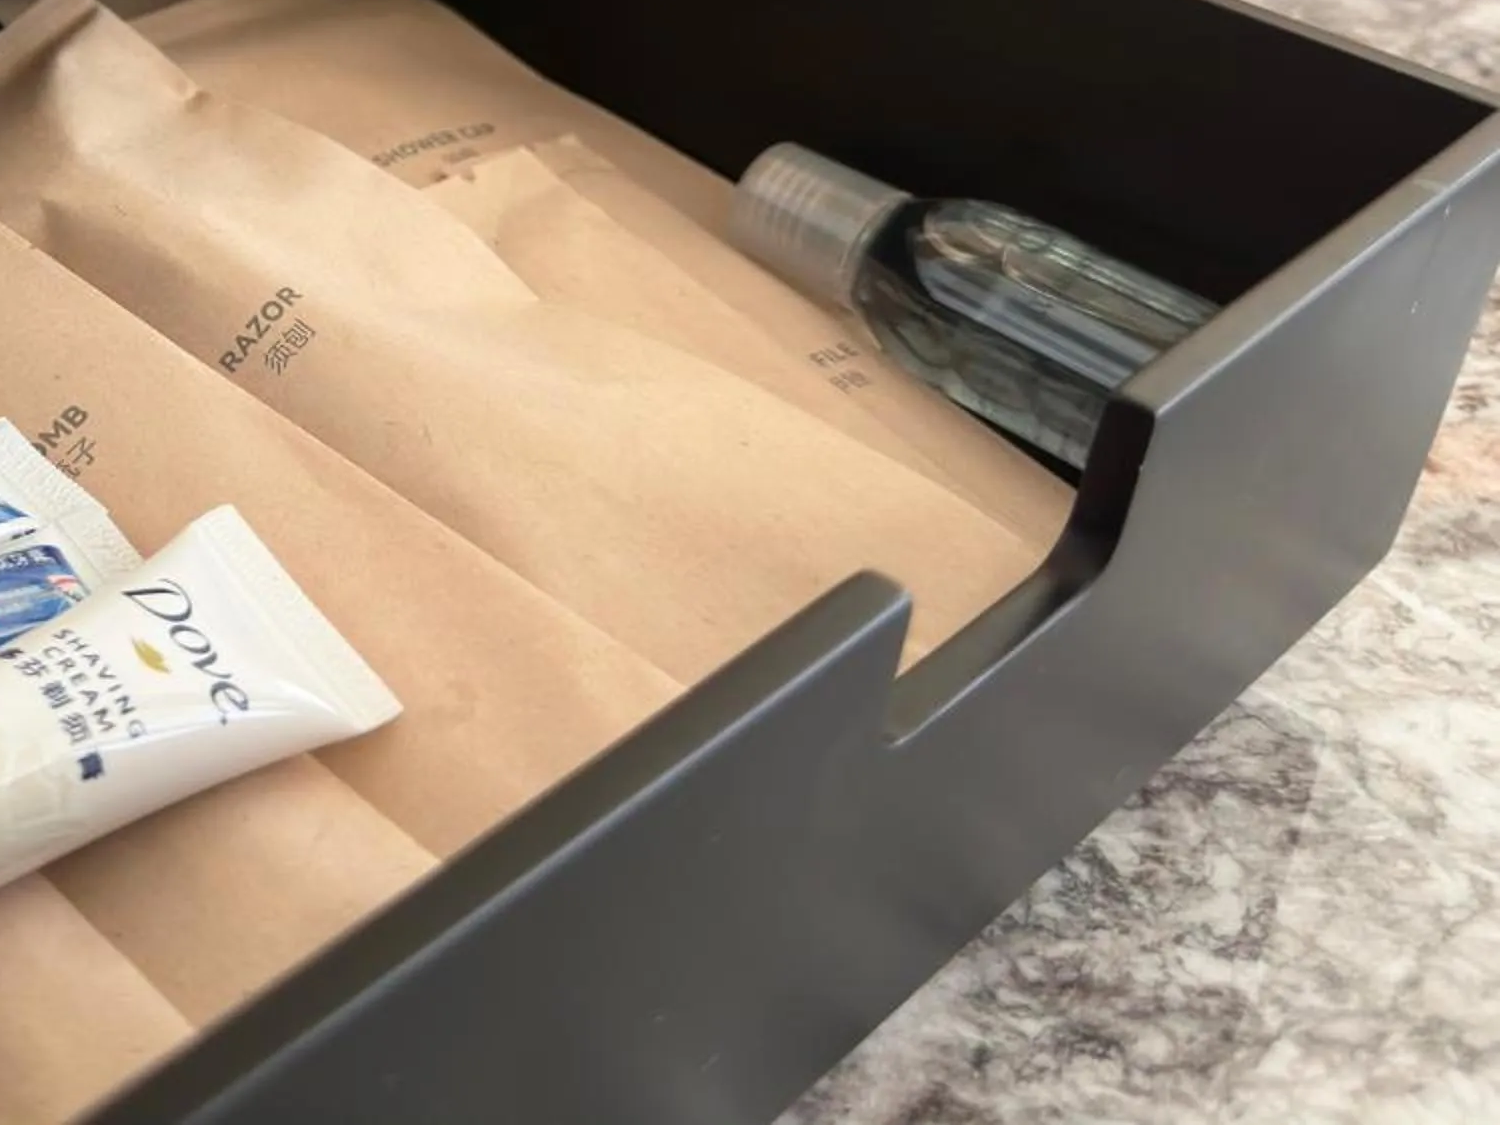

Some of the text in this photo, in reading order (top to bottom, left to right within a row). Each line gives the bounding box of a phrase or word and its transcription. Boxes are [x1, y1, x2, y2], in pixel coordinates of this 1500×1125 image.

[219, 286, 304, 374] RAZOR
[42, 645, 117, 732] CREAM
[51, 627, 147, 739] SHAVING
[120, 577, 250, 715] Dove
